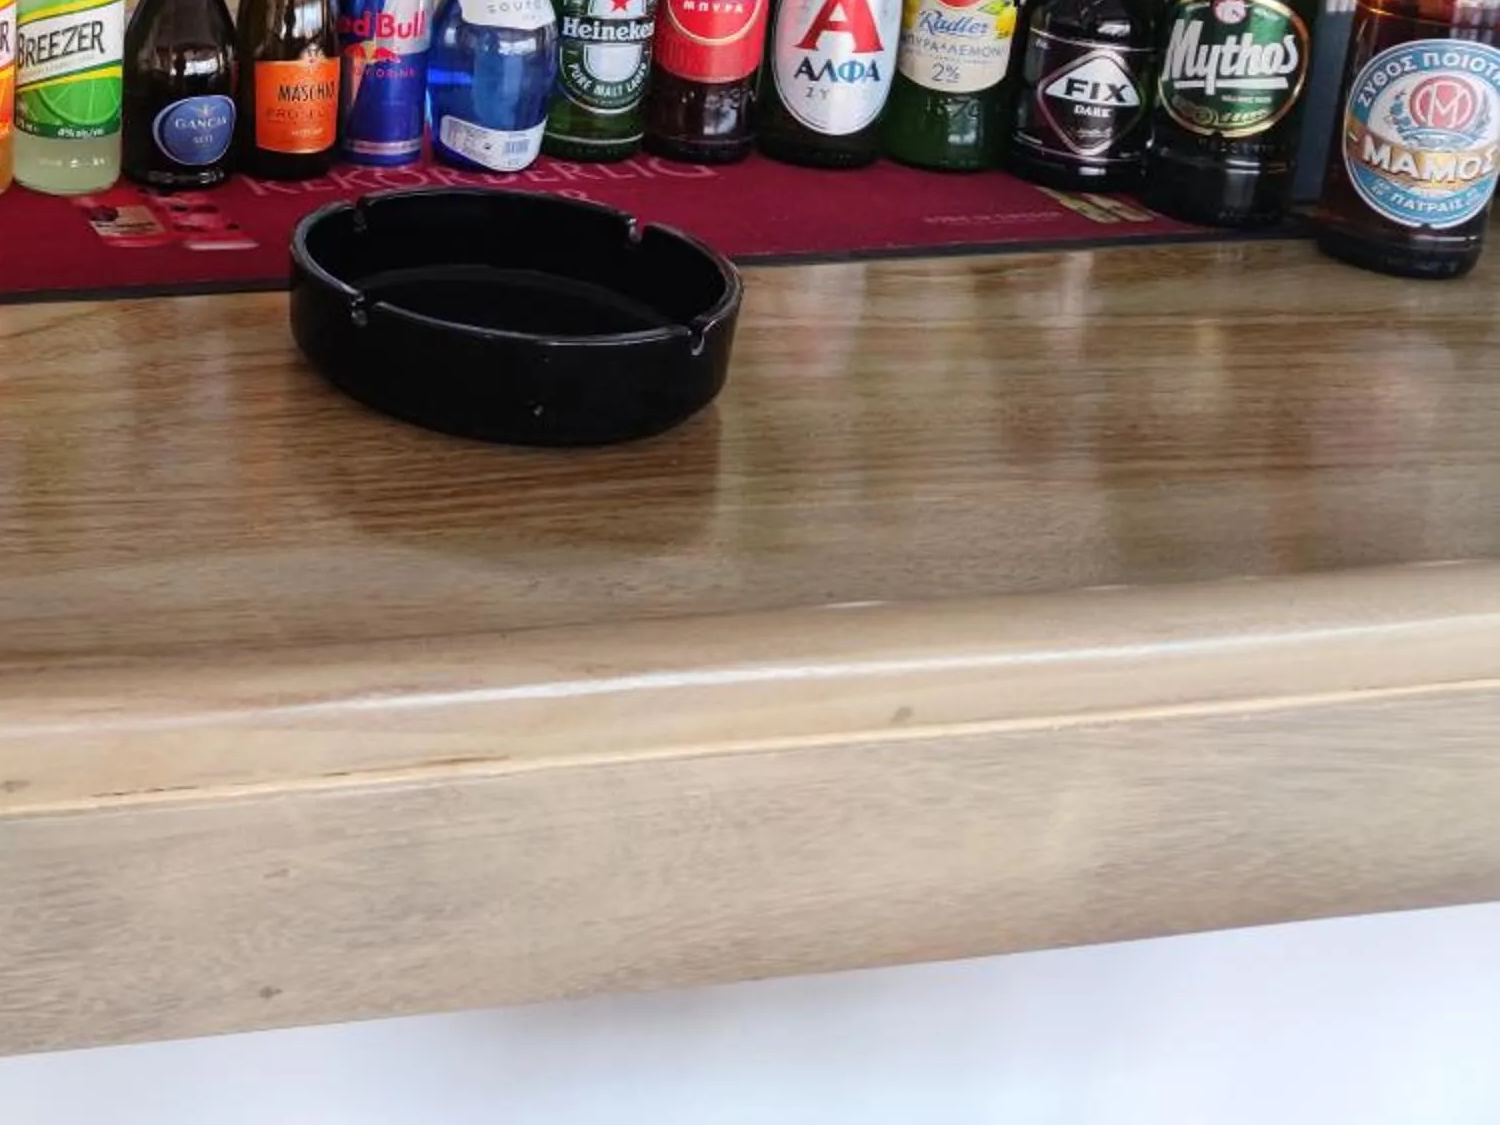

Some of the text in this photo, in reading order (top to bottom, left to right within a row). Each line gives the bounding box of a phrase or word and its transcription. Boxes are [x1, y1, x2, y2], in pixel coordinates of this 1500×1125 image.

[376, 11, 426, 39] Bull
[17, 20, 105, 70] BREEZER
[1161, 18, 1299, 96] Mythos
[793, 56, 881, 83] ΑΛΦΑ
[1357, 53, 1418, 108] ΖΥΘΟΣ
[593, 83, 624, 97] MALT
[1063, 78, 1129, 103] FIX
[1073, 104, 1114, 118] DARK
